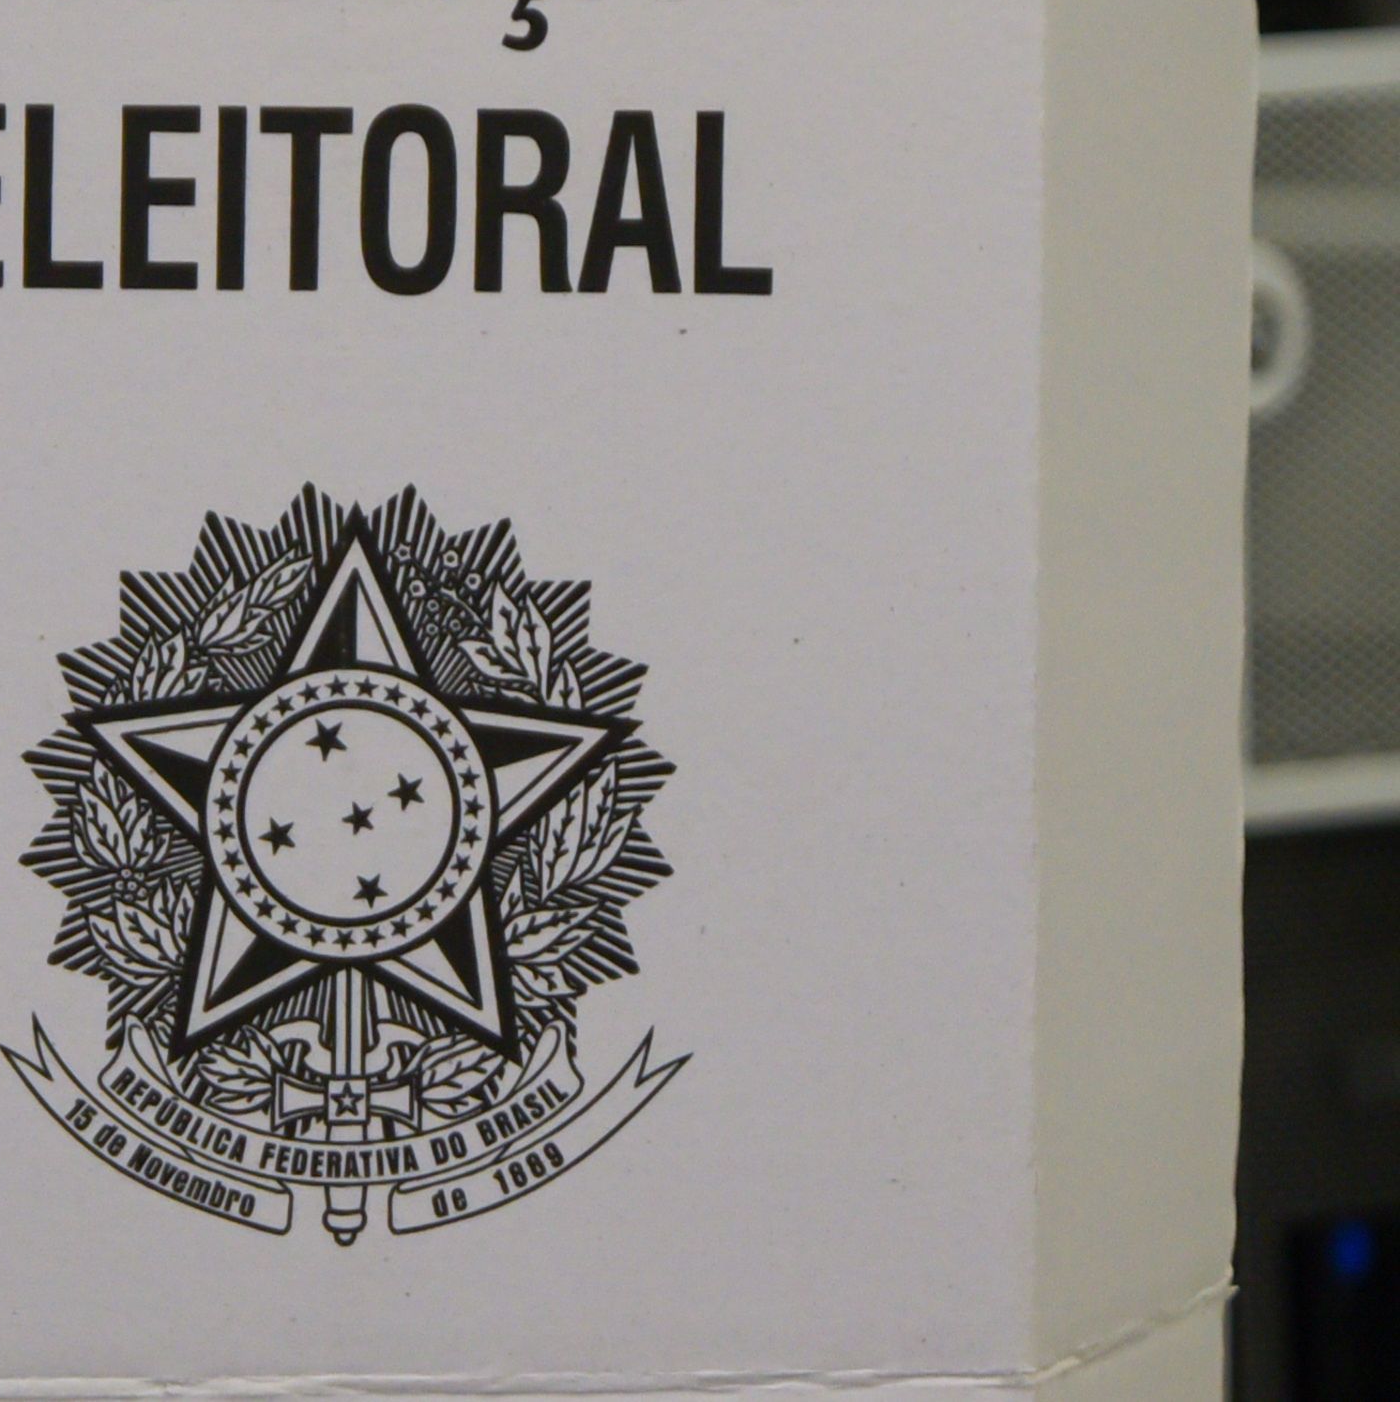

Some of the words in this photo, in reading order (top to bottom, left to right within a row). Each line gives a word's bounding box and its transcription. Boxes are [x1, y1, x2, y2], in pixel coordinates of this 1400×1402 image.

[64, 1098, 98, 1131] 15
[93, 1122, 127, 1157] de
[127, 1142, 256, 1218] Novembro
[431, 1187, 468, 1218] de
[493, 1142, 564, 1195] 1889
[110, 1066, 247, 1163] REPÚBLICA
[259, 1141, 419, 1178] FEDERATIVA
[429, 1131, 467, 1166] DO
[475, 1078, 569, 1147] BRASIL
